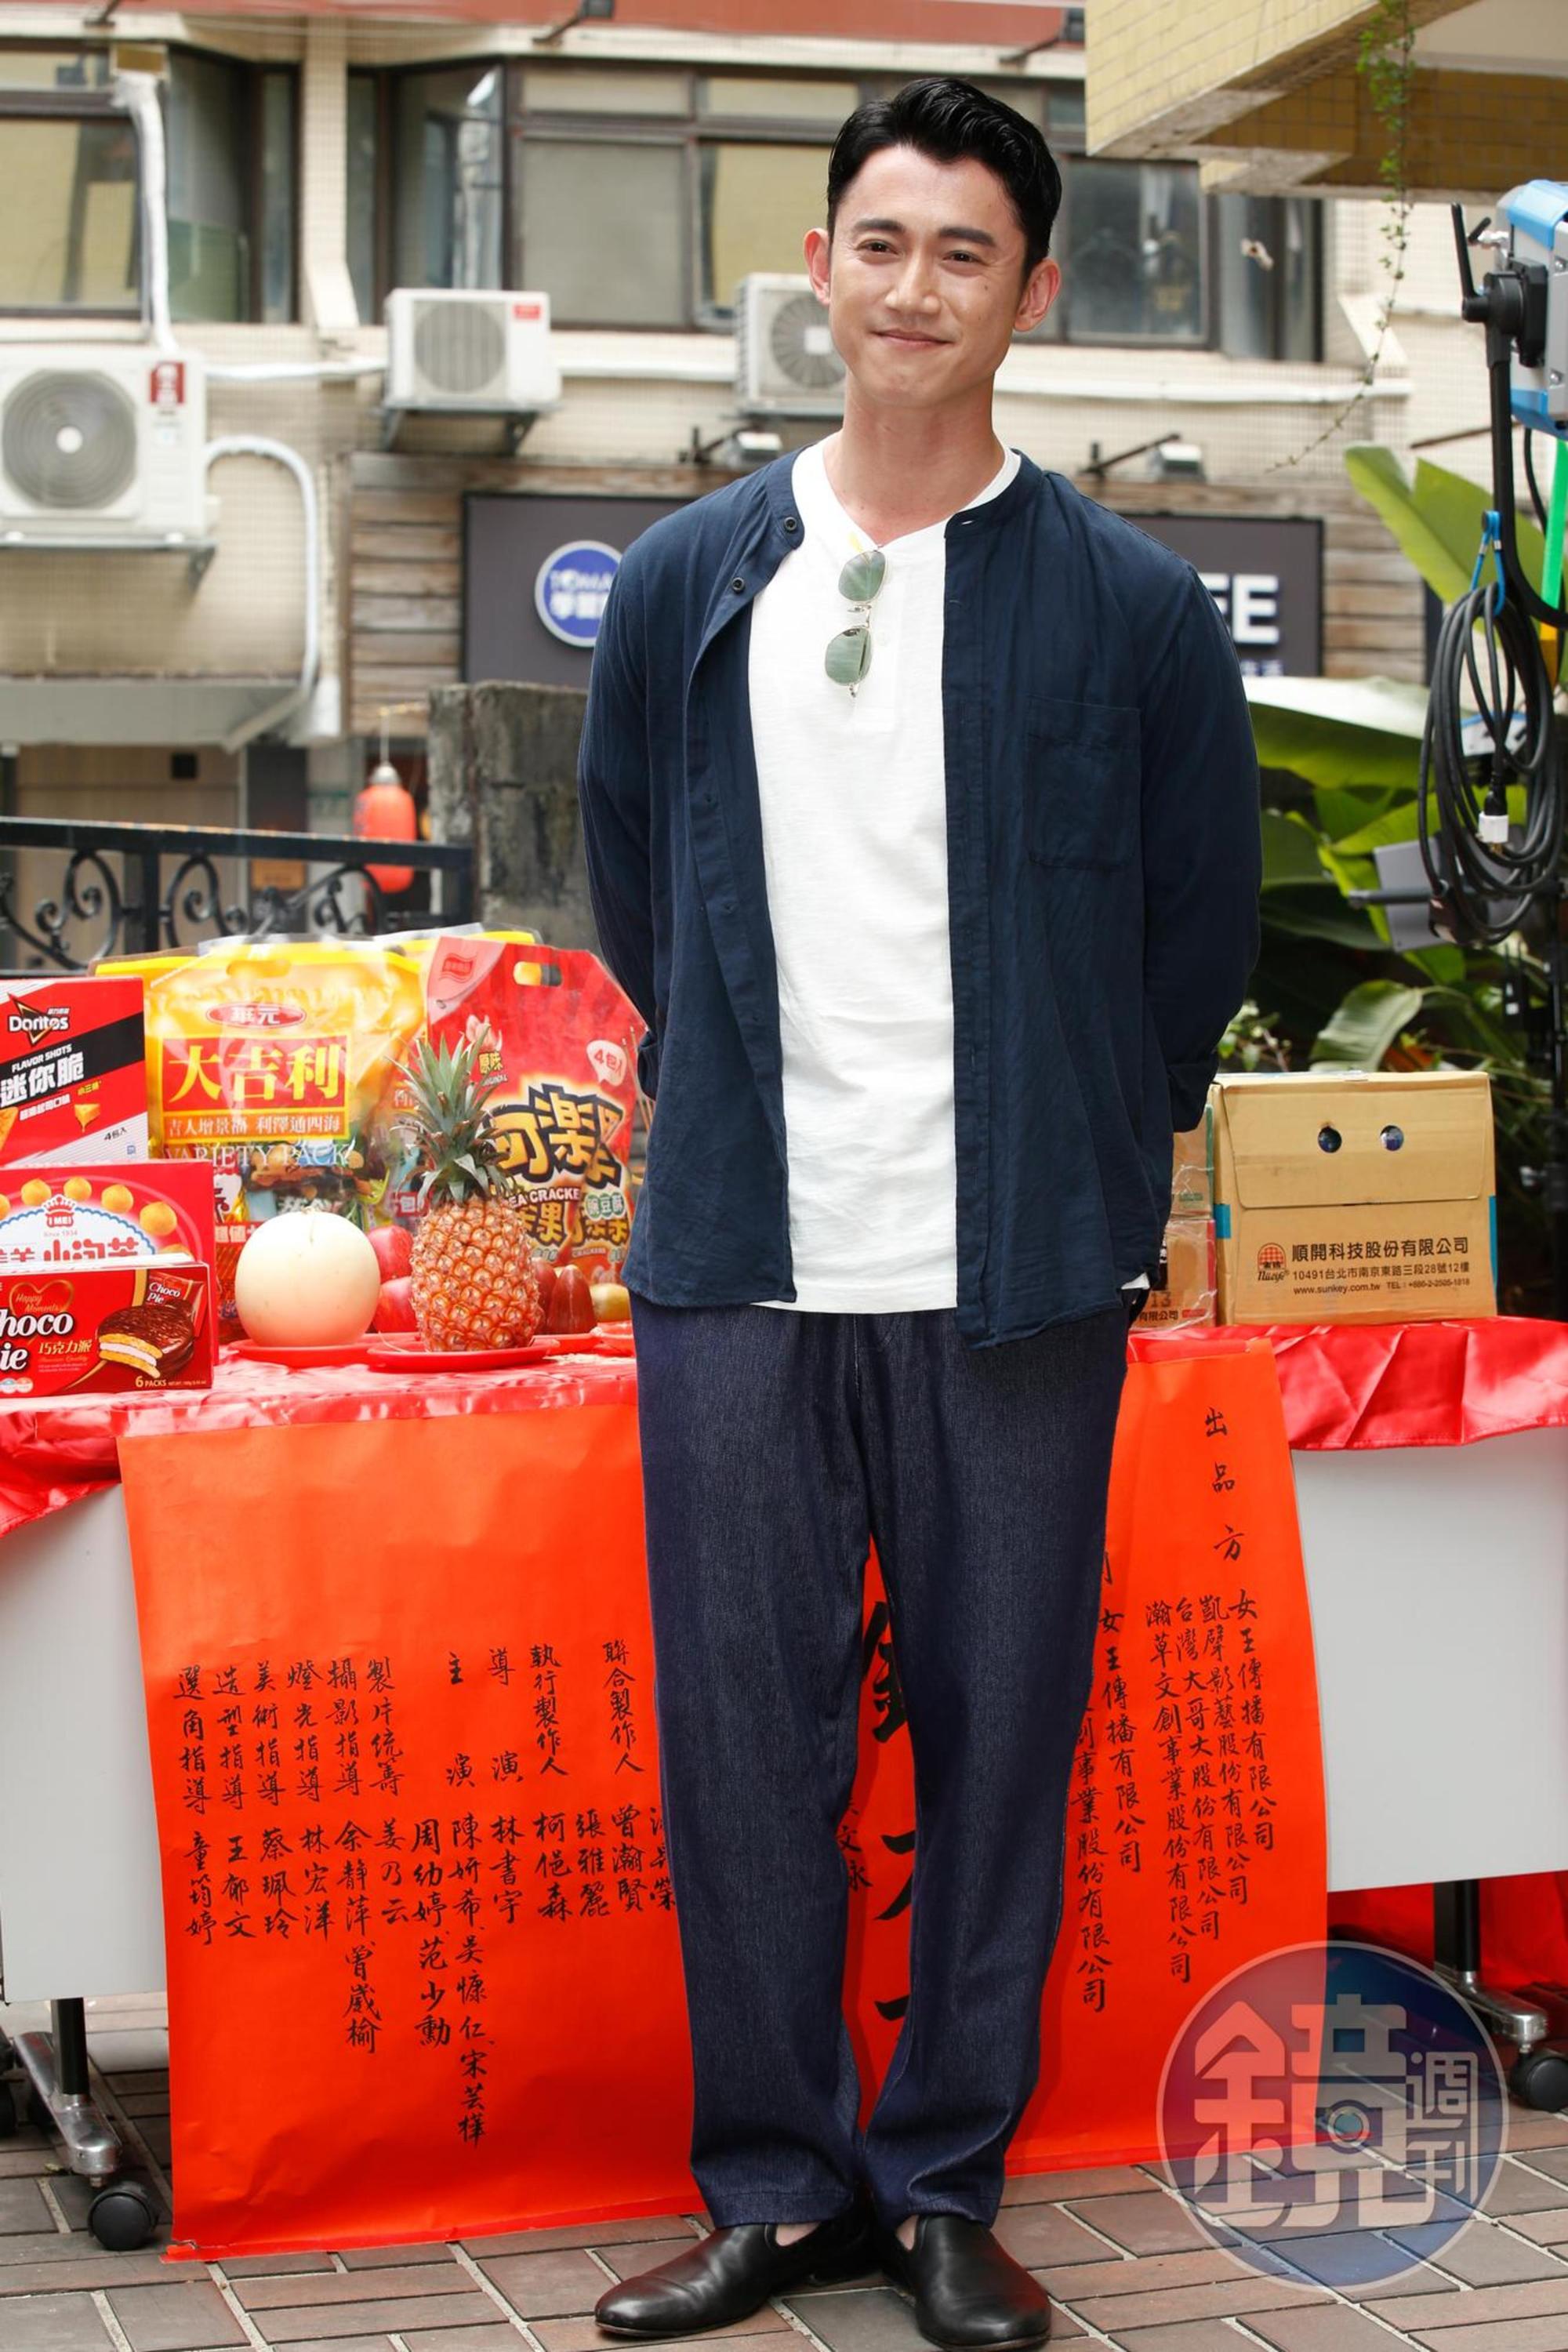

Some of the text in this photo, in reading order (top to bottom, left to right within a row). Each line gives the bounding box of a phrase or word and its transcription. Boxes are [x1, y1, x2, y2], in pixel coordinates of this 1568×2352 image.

[9, 1016, 69, 1032] Doritos
[12, 1044, 72, 1073] FLAVOR SHOTS
[168, 1044, 341, 1103] 大吉利
[0, 1051, 84, 1108] 迷你脆
[166, 1145, 353, 1167] VARIETY PACK
[529, 1187, 580, 1203] CRACKE
[16, 1294, 42, 1305] Happy
[147, 1292, 165, 1305] Pie
[148, 1281, 181, 1298] Choco
[1292, 1236, 1468, 1262] 順開科技股份有限公司
[0, 1308, 74, 1338] hoco
[0, 1341, 28, 1371] ie
[38, 1338, 92, 1356] 巧克力派
[135, 1376, 144, 1388] 6
[145, 1378, 167, 1387] PACKS
[1205, 1406, 1244, 1561] 出品方
[173, 1664, 212, 1815] 選角指導
[212, 1665, 249, 1809] 造型指導
[252, 1660, 285, 1806] 美術指導
[288, 1660, 325, 1802] 燈光指導
[325, 1657, 363, 1795] 攝影指導
[529, 1643, 569, 1776] 執行製作人
[602, 1639, 645, 1775] 聯合製作人
[1098, 1608, 1145, 1873] 女王傳播有限公司
[1228, 1589, 1277, 1851] 女王傳播有限公司
[1145, 1600, 1197, 1984] 瀚草文創事業股份有限公司
[1176, 1597, 1226, 1940] 台灣大哥大股份有限公司
[489, 1815, 524, 1924] 林書宇
[576, 1809, 610, 1917] 張雅麗
[1070, 1706, 1113, 2013] 創事業股份有限公司
